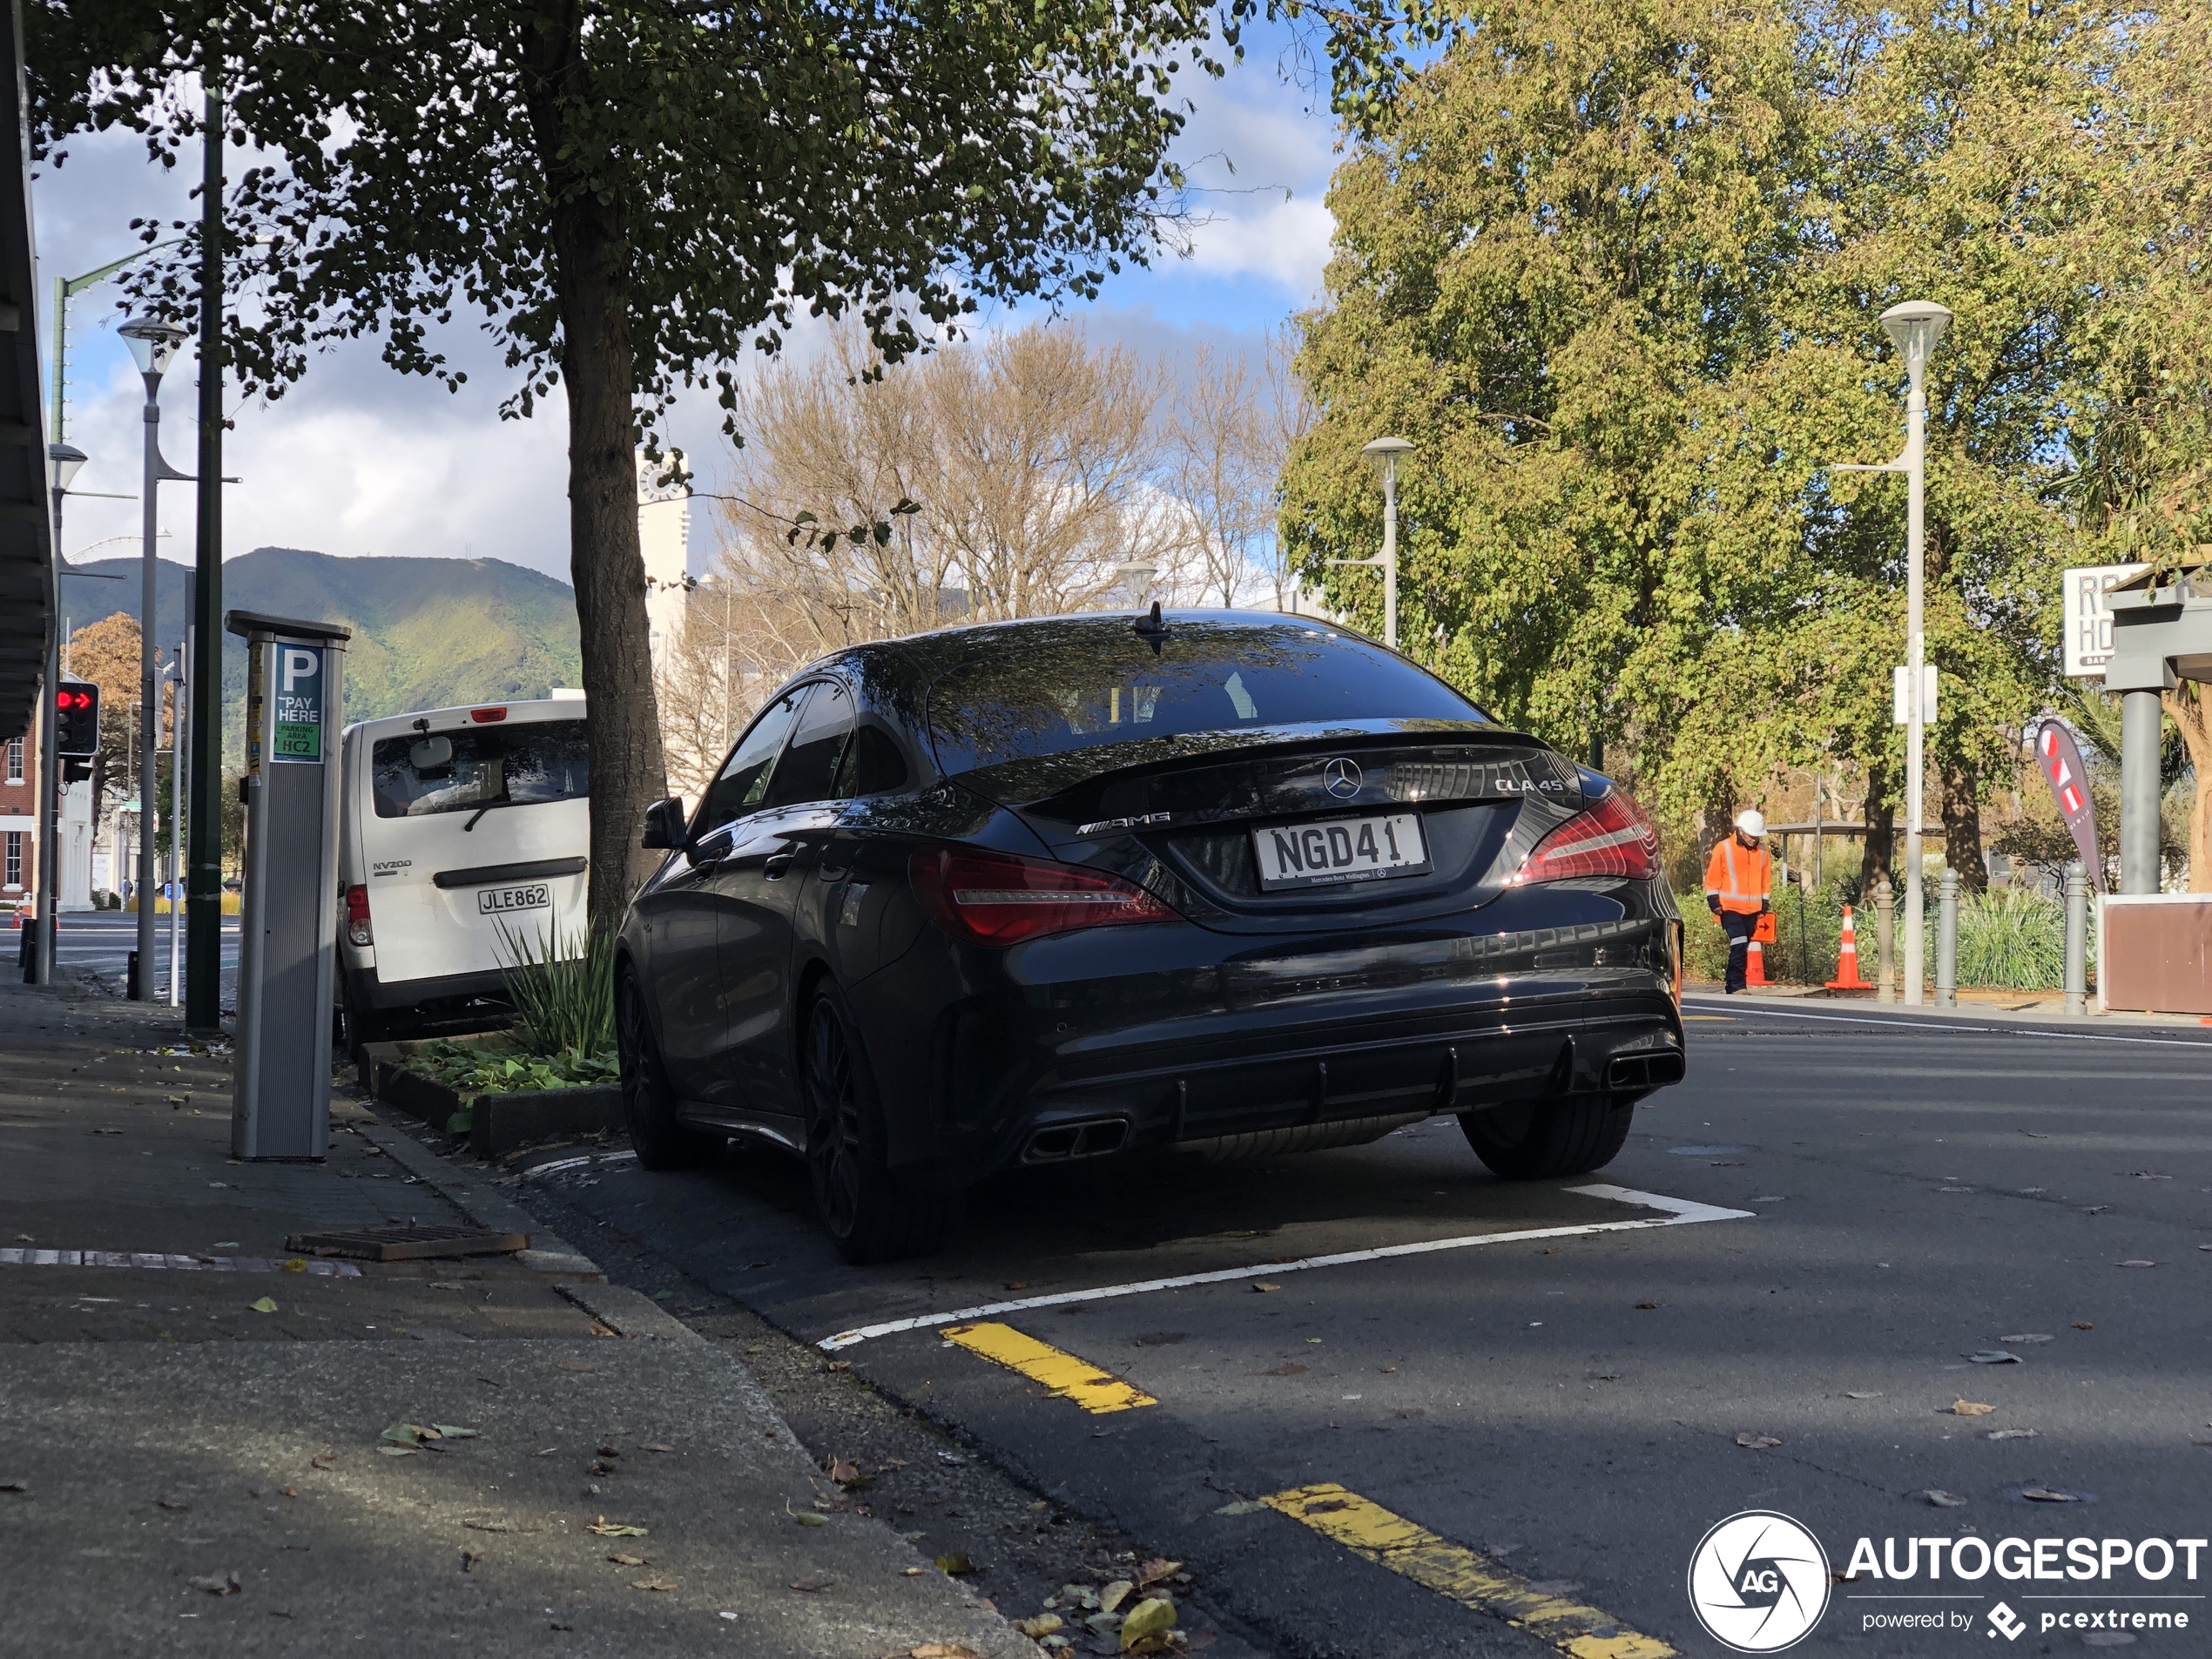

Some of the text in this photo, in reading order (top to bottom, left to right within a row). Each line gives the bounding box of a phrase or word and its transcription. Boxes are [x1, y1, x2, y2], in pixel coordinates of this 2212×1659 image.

[283, 649, 319, 692] P
[286, 697, 313, 709] PAY
[279, 709, 319, 723] HERE
[280, 725, 314, 733] PARKING
[282, 740, 311, 752] HC2
[1495, 779, 1564, 792] CLA 45
[1274, 820, 1402, 873] NGD41
[373, 860, 413, 870] NV200
[1311, 872, 1371, 884] Mercedes-Benz Wellington
[482, 887, 547, 911] JLE862
